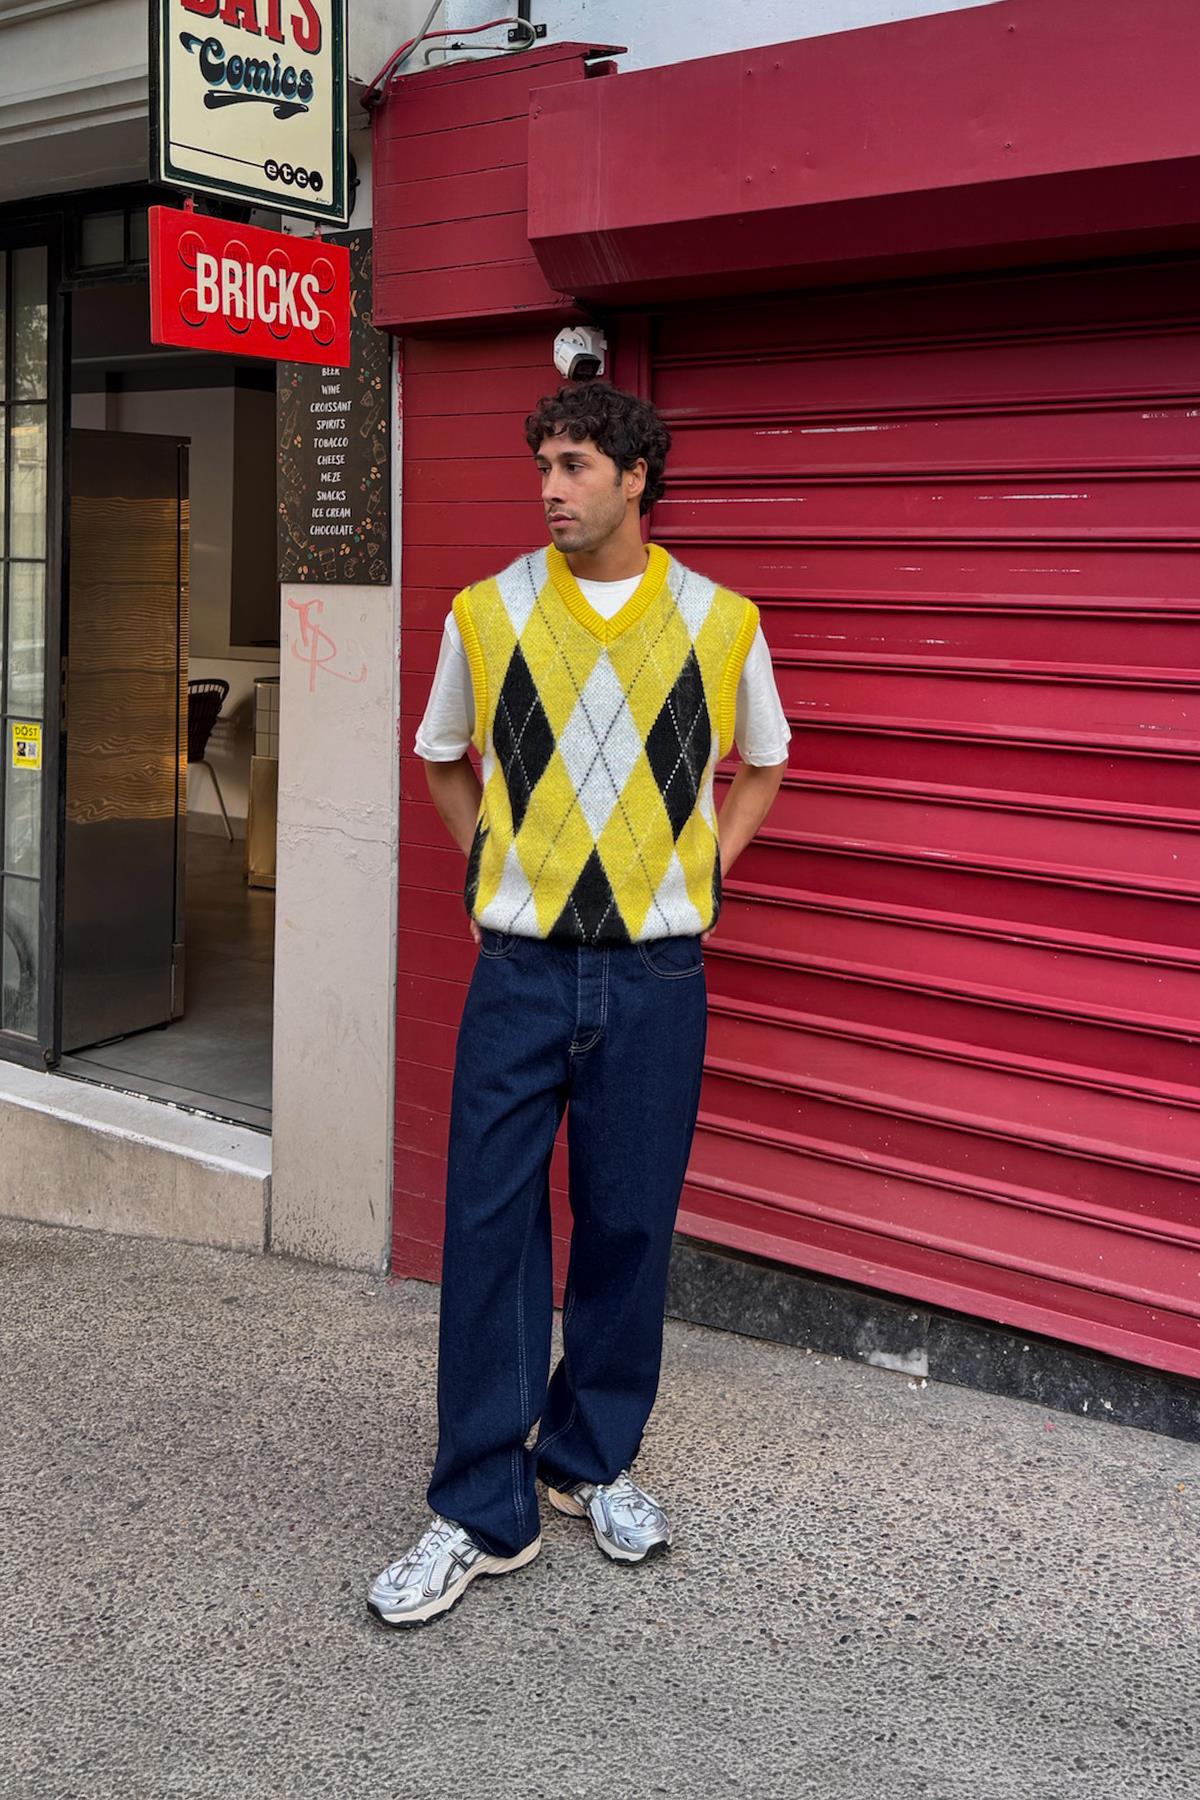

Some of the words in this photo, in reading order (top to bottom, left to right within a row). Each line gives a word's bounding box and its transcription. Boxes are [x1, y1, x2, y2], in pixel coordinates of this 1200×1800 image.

[180, 32, 313, 103] Comics
[196, 252, 320, 331] BRICKS
[321, 384, 341, 395] WINE
[310, 400, 352, 413] CROISSANT
[316, 418, 346, 431] SPIRITS
[313, 436, 349, 449] TOBACCO
[317, 454, 345, 466] CHEESE
[320, 471, 342, 483] MEZE
[316, 489, 347, 502] SNACKS
[312, 508, 325, 519] ICE
[326, 507, 351, 519] CREAM
[310, 524, 354, 536] CHOCOLATE
